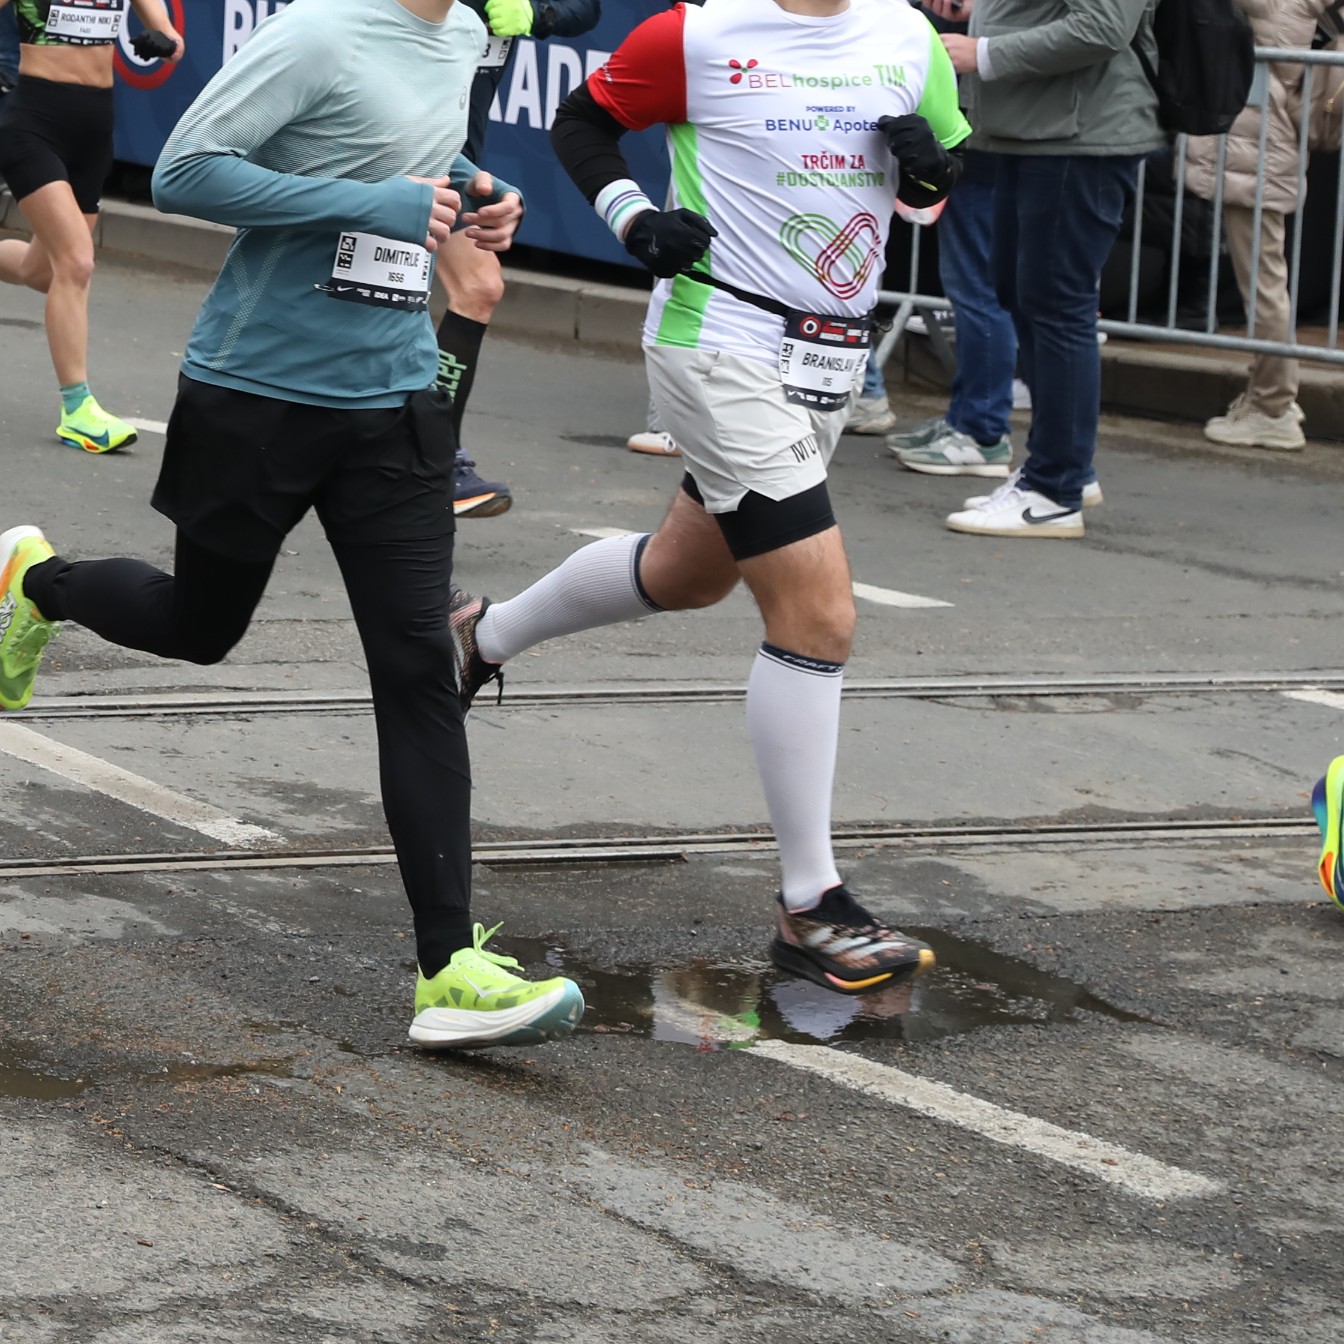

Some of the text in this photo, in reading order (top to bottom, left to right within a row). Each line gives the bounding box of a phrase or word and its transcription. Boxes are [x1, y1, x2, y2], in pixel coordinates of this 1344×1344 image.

[748, 64, 907, 91] BELhospice TIM
[765, 119, 878, 134] BENU Apote
[801, 150, 866, 170] TRČIM ZA
